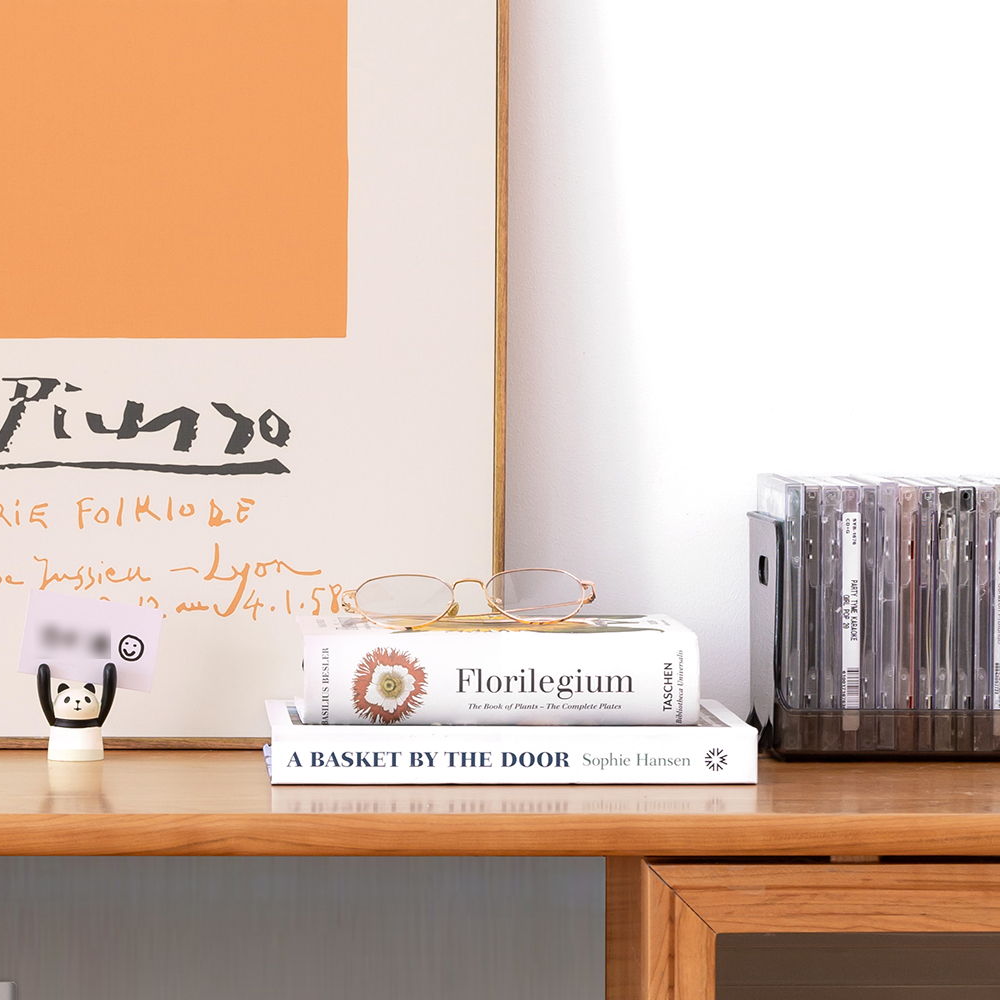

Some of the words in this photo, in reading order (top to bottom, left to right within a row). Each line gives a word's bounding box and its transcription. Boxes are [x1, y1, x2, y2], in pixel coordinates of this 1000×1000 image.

[850, 616, 858, 641] KARAOKE
[321, 647, 329, 684] BESLER
[676, 649, 684, 687] Universalis
[456, 667, 635, 700] Florilegium
[662, 662, 673, 712] TASCHEN
[321, 686, 329, 725] BASILIUS
[504, 703, 514, 711] of
[562, 703, 598, 711] Complete
[676, 688, 684, 725] Bibliotheca
[286, 751, 303, 768] A
[311, 751, 402, 768] BASKET
[409, 751, 439, 768] BY
[445, 751, 493, 768] THE
[501, 751, 570, 768] DOOR
[582, 752, 631, 771] Sophie
[636, 753, 691, 768] Hansen
